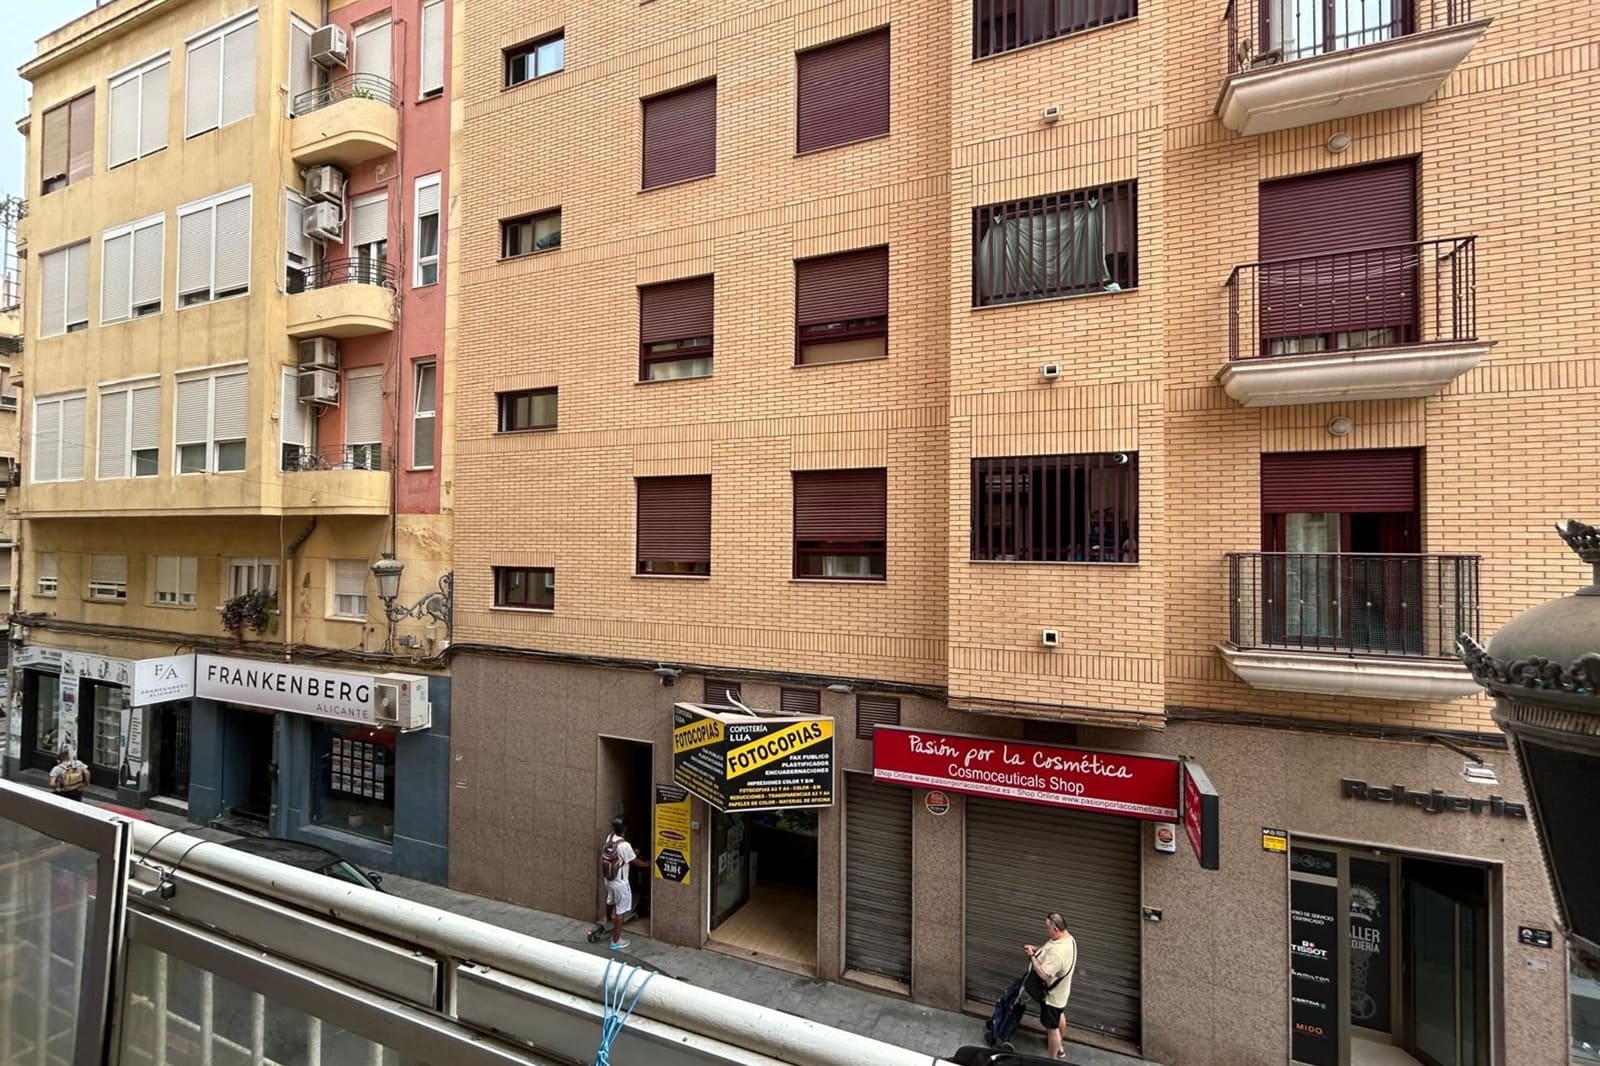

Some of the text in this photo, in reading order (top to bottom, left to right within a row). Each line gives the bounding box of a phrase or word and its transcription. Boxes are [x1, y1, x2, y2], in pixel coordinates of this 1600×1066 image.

[155, 664, 178, 680] F/A
[208, 665, 369, 703] FRANKENBERG
[317, 704, 368, 719] ALICANTE
[675, 721, 719, 748] FOTOCOPIAS
[730, 724, 768, 733] COPISTERÍA
[728, 723, 822, 772] FOTOCOPIAS
[908, 734, 960, 758] Pasión
[964, 747, 995, 767] por
[1033, 751, 1133, 779] Cosmética
[948, 763, 1085, 795] Cosmoceuticals Shop
[1016, 789, 1036, 798] Shop
[1037, 791, 1060, 801] Online
[1349, 925, 1380, 943] LLER
[1291, 944, 1328, 956] TISSOT
[1296, 1023, 1322, 1034] MIDO
